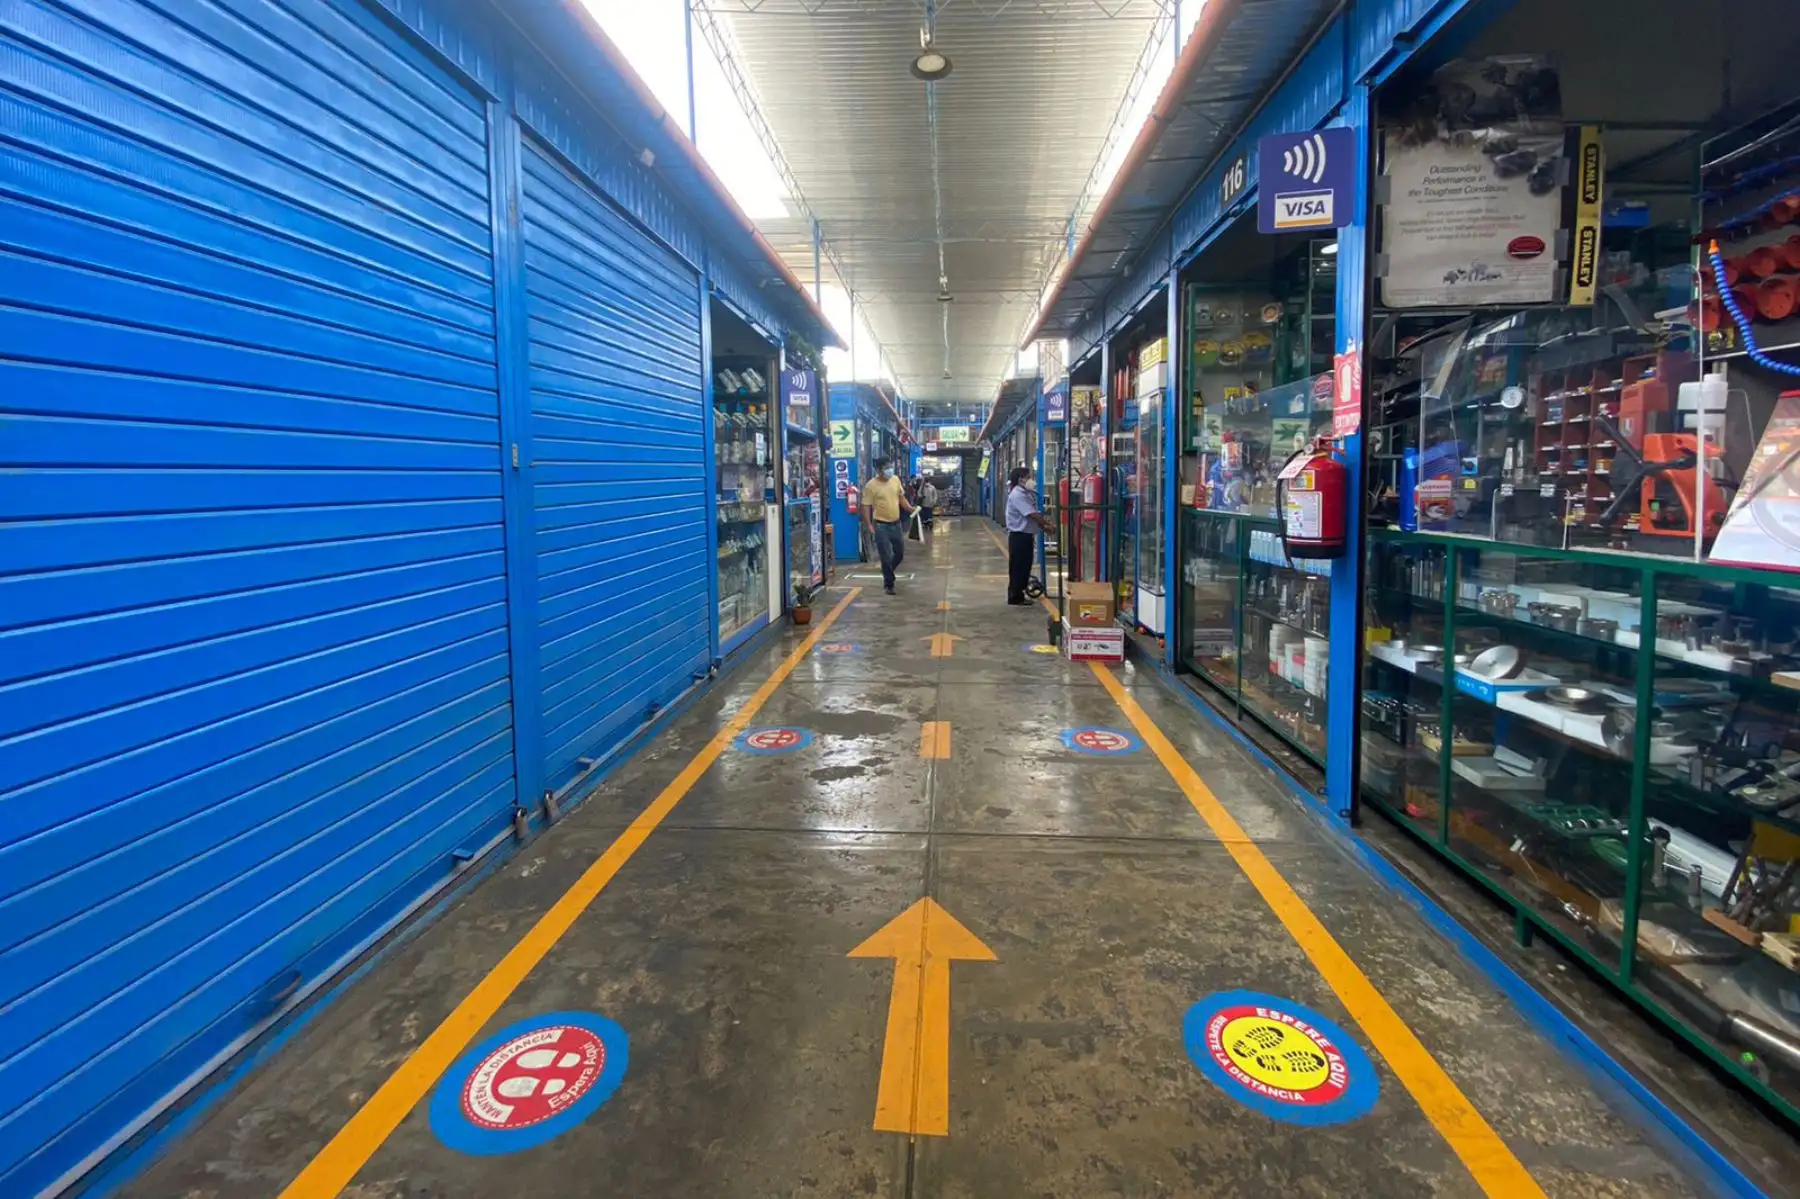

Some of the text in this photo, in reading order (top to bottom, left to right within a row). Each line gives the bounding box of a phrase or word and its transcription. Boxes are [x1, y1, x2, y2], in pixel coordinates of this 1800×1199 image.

[1222, 158, 1243, 202] 116
[1584, 146, 1598, 201] STANLEY
[1285, 199, 1326, 217] VISA
[1579, 230, 1594, 284] STANLEY
[481, 1071, 495, 1085] LA
[489, 1032, 555, 1069] DISTANCIA
[1207, 1015, 1305, 1102] RESPETE LA DISTANCIA
[1255, 1007, 1346, 1089] ESPERE AQUI
[548, 1066, 595, 1109] Espera
